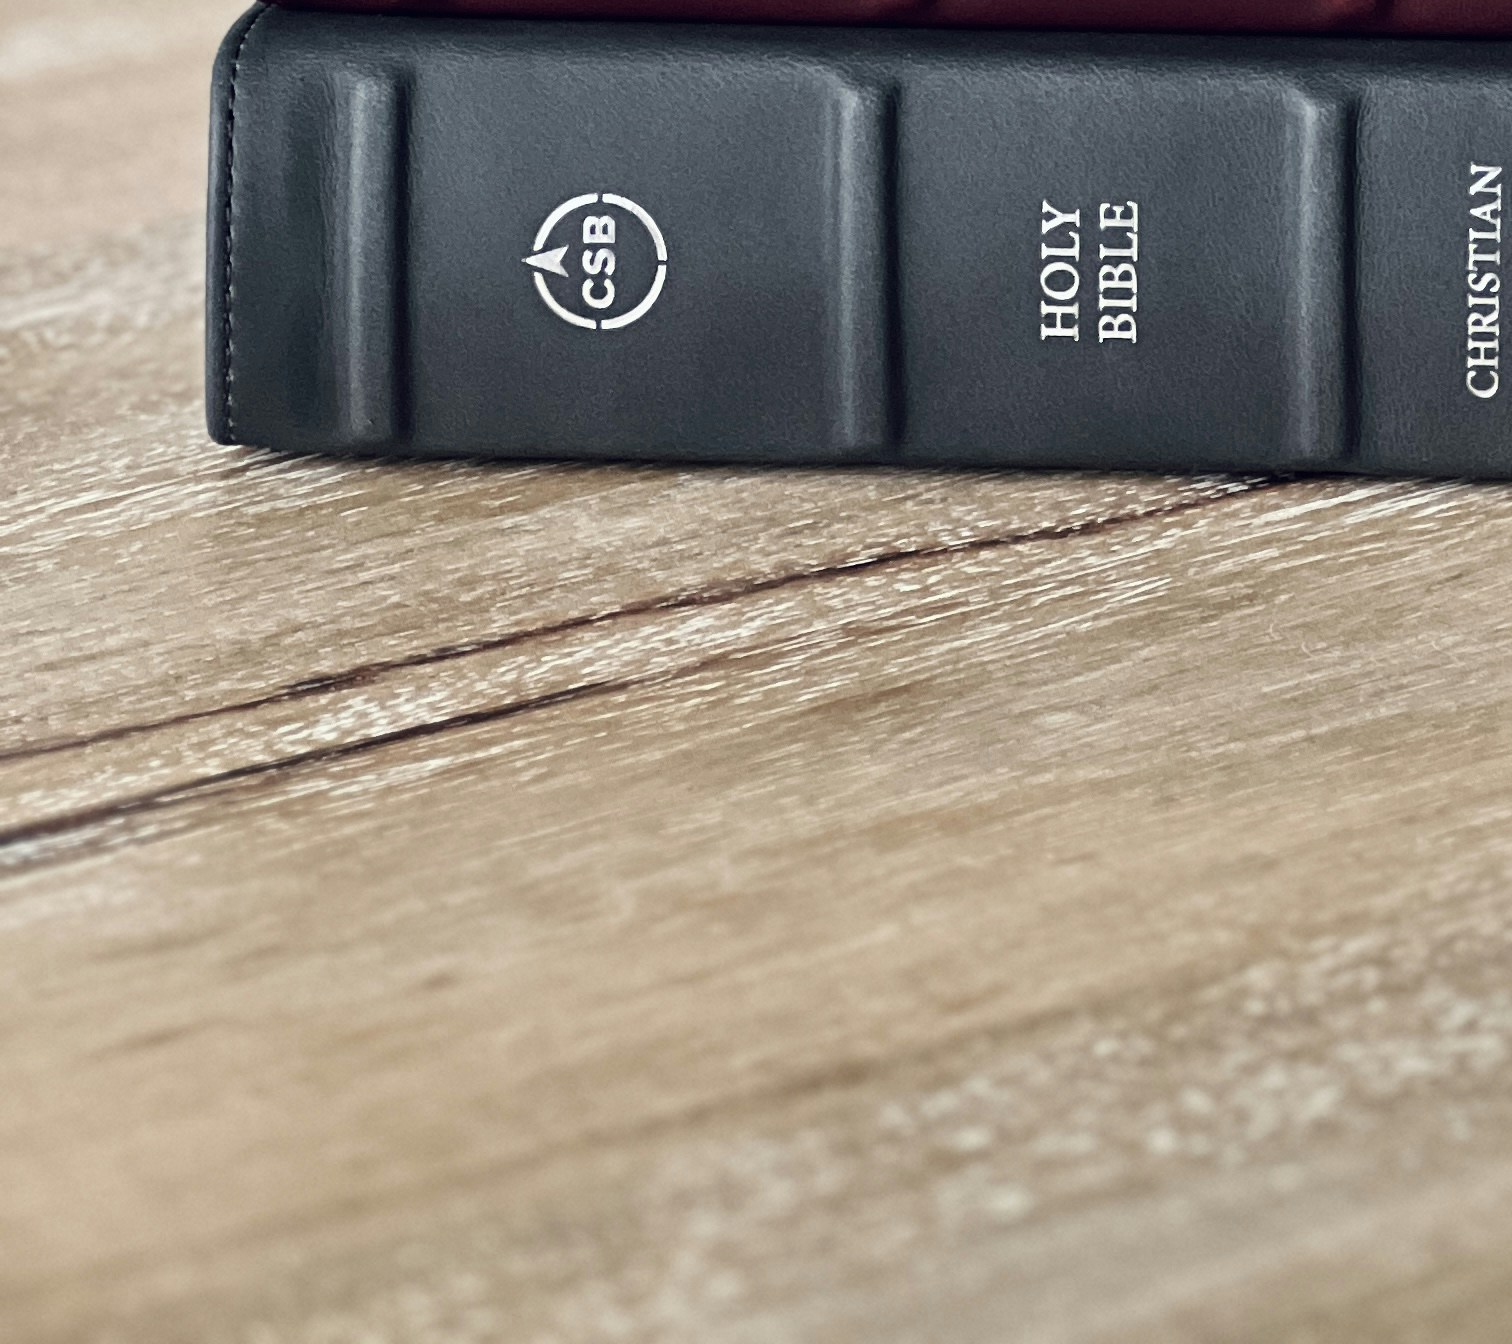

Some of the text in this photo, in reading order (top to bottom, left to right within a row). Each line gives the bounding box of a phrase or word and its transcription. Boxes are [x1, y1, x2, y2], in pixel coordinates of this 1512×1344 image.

[582, 216, 615, 309] CSB
[1040, 200, 1080, 341] HOLY
[1098, 201, 1138, 343] BIBLE
[1466, 162, 1502, 398] CHRISTIAN
